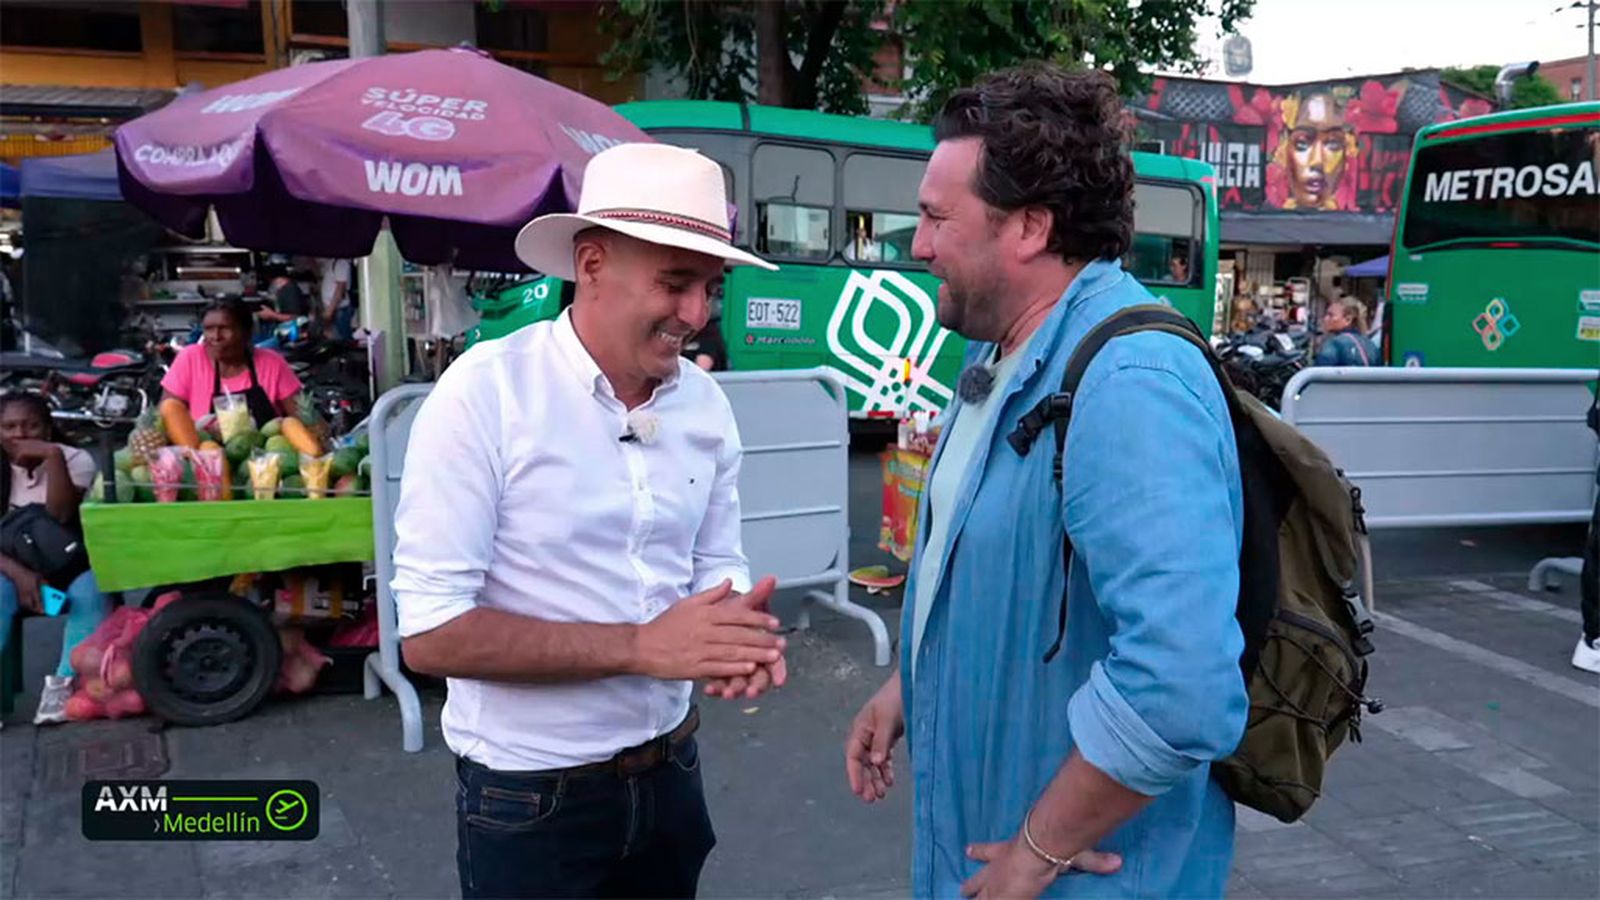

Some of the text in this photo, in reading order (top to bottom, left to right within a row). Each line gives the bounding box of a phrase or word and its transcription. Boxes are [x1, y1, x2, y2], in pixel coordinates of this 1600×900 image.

[361, 93, 486, 120] VELOCIDAD
[364, 87, 488, 112] SÚPER
[363, 159, 464, 197] WOM
[1424, 161, 1600, 202] METROSA
[522, 283, 548, 305] 20
